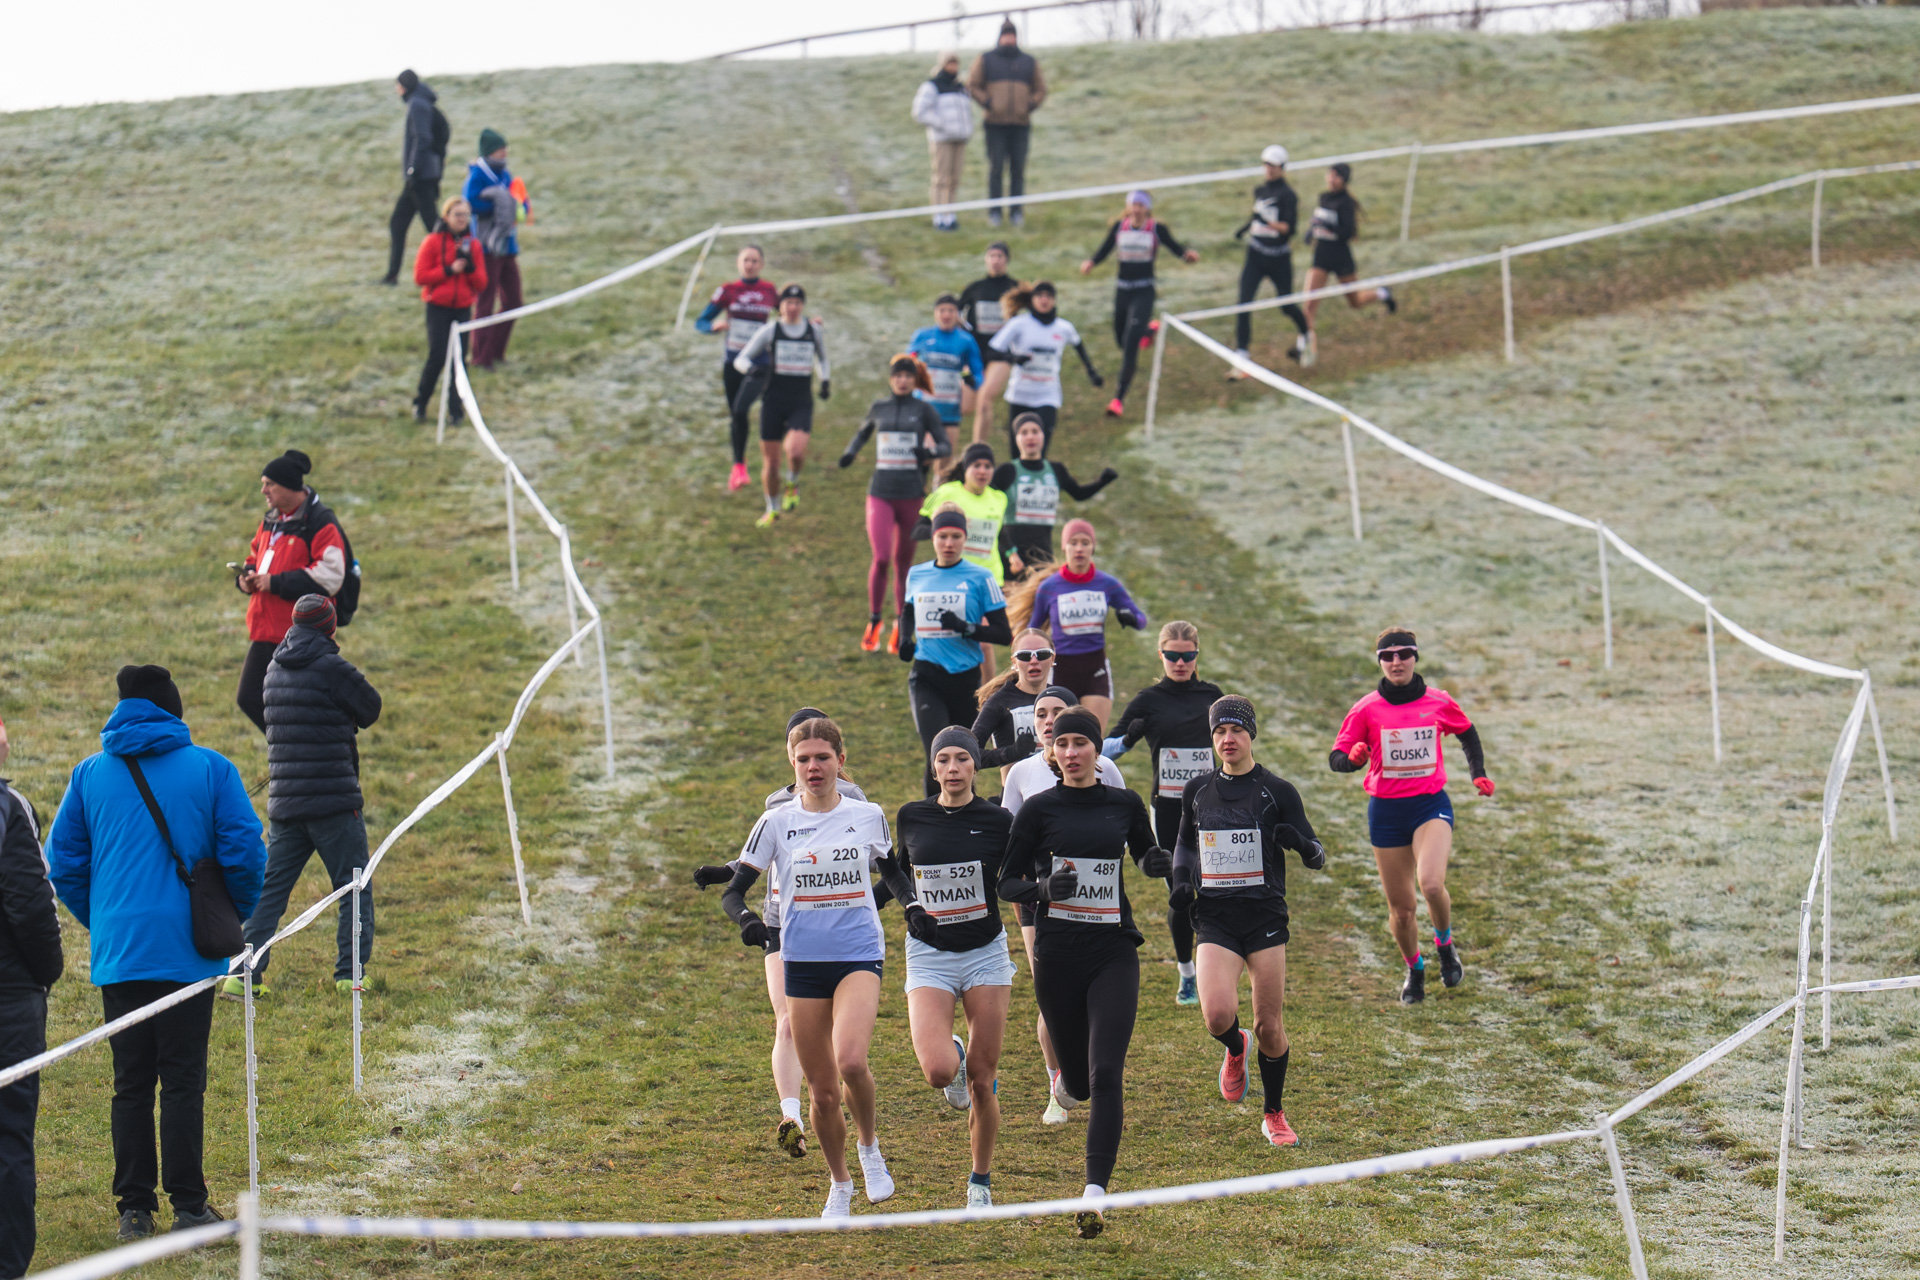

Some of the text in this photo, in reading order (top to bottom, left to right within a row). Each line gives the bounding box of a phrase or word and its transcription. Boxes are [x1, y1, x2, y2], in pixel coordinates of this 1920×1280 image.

[942, 595, 960, 604] 517
[1414, 729, 1433, 740] 112
[1192, 751, 1210, 761] 500
[1390, 747, 1430, 760] GUSKA
[1231, 832, 1255, 844] 801
[832, 848, 859, 861] 220
[1203, 848, 1255, 873] DĘBSKA
[949, 865, 976, 879] 529
[1093, 863, 1116, 875] 489
[795, 870, 862, 889] STRZĄBAŁA
[922, 886, 976, 903] TYMAN
[1073, 885, 1113, 900] AMM
[953, 914, 970, 922] 2025
